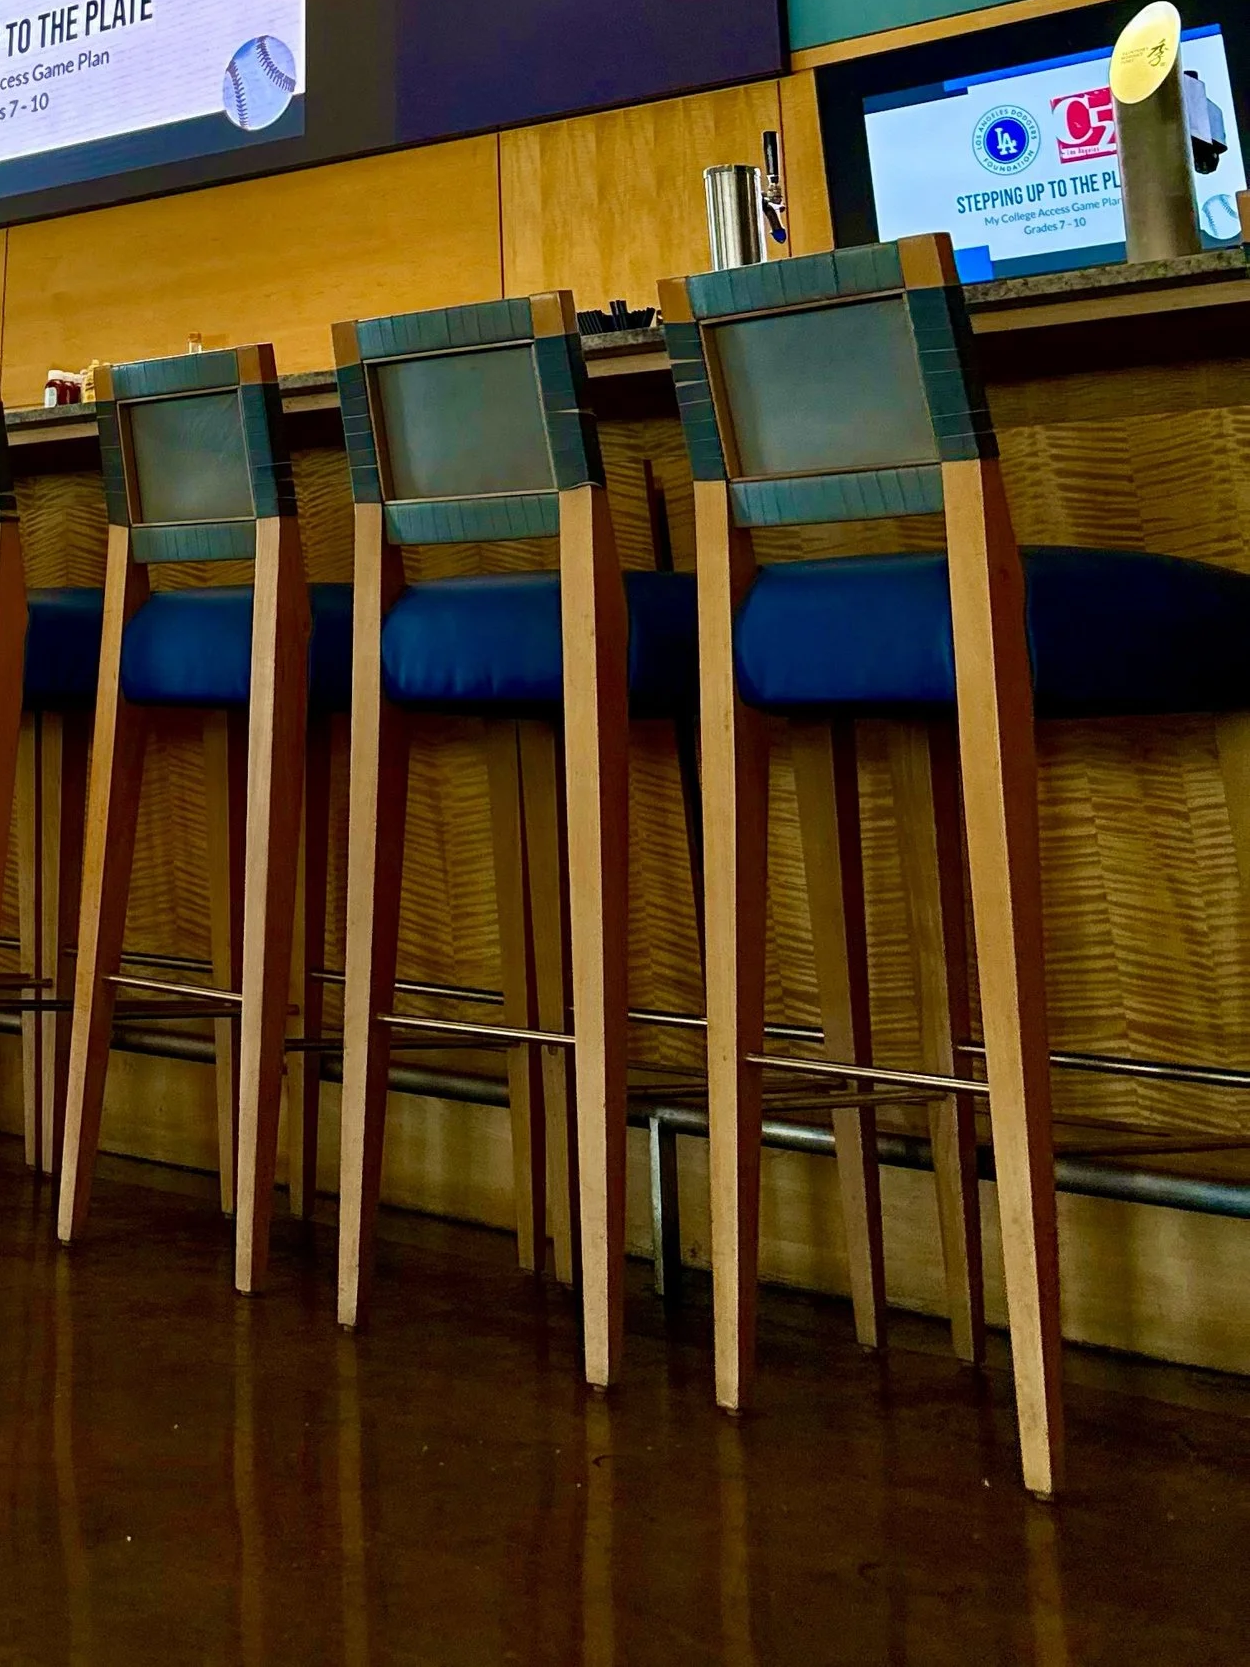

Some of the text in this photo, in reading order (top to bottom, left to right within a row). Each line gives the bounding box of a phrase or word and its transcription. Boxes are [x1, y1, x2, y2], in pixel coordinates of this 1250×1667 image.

[6, 18, 31, 58] TO
[38, 4, 79, 48] THE
[32, 61, 74, 82] Game
[78, 50, 110, 71] Plan
[9, 100, 19, 118] 7
[31, 92, 49, 113] 10
[975, 134, 983, 150] LOS
[1011, 109, 1037, 140] DODGERS
[994, 127, 1018, 155] LA
[983, 149, 1035, 172] FOUNDATION
[956, 186, 1023, 214] STEPPING
[1026, 183, 1045, 203] UP
[1048, 180, 1067, 199] TO
[1070, 173, 1099, 195] THE
[984, 216, 999, 227] My
[1001, 211, 1036, 224] College
[1038, 205, 1070, 217] Access
[1071, 202, 1100, 213] Game
[1024, 223, 1058, 235] Grades
[1059, 221, 1065, 229] 7
[1074, 217, 1086, 227] 10
